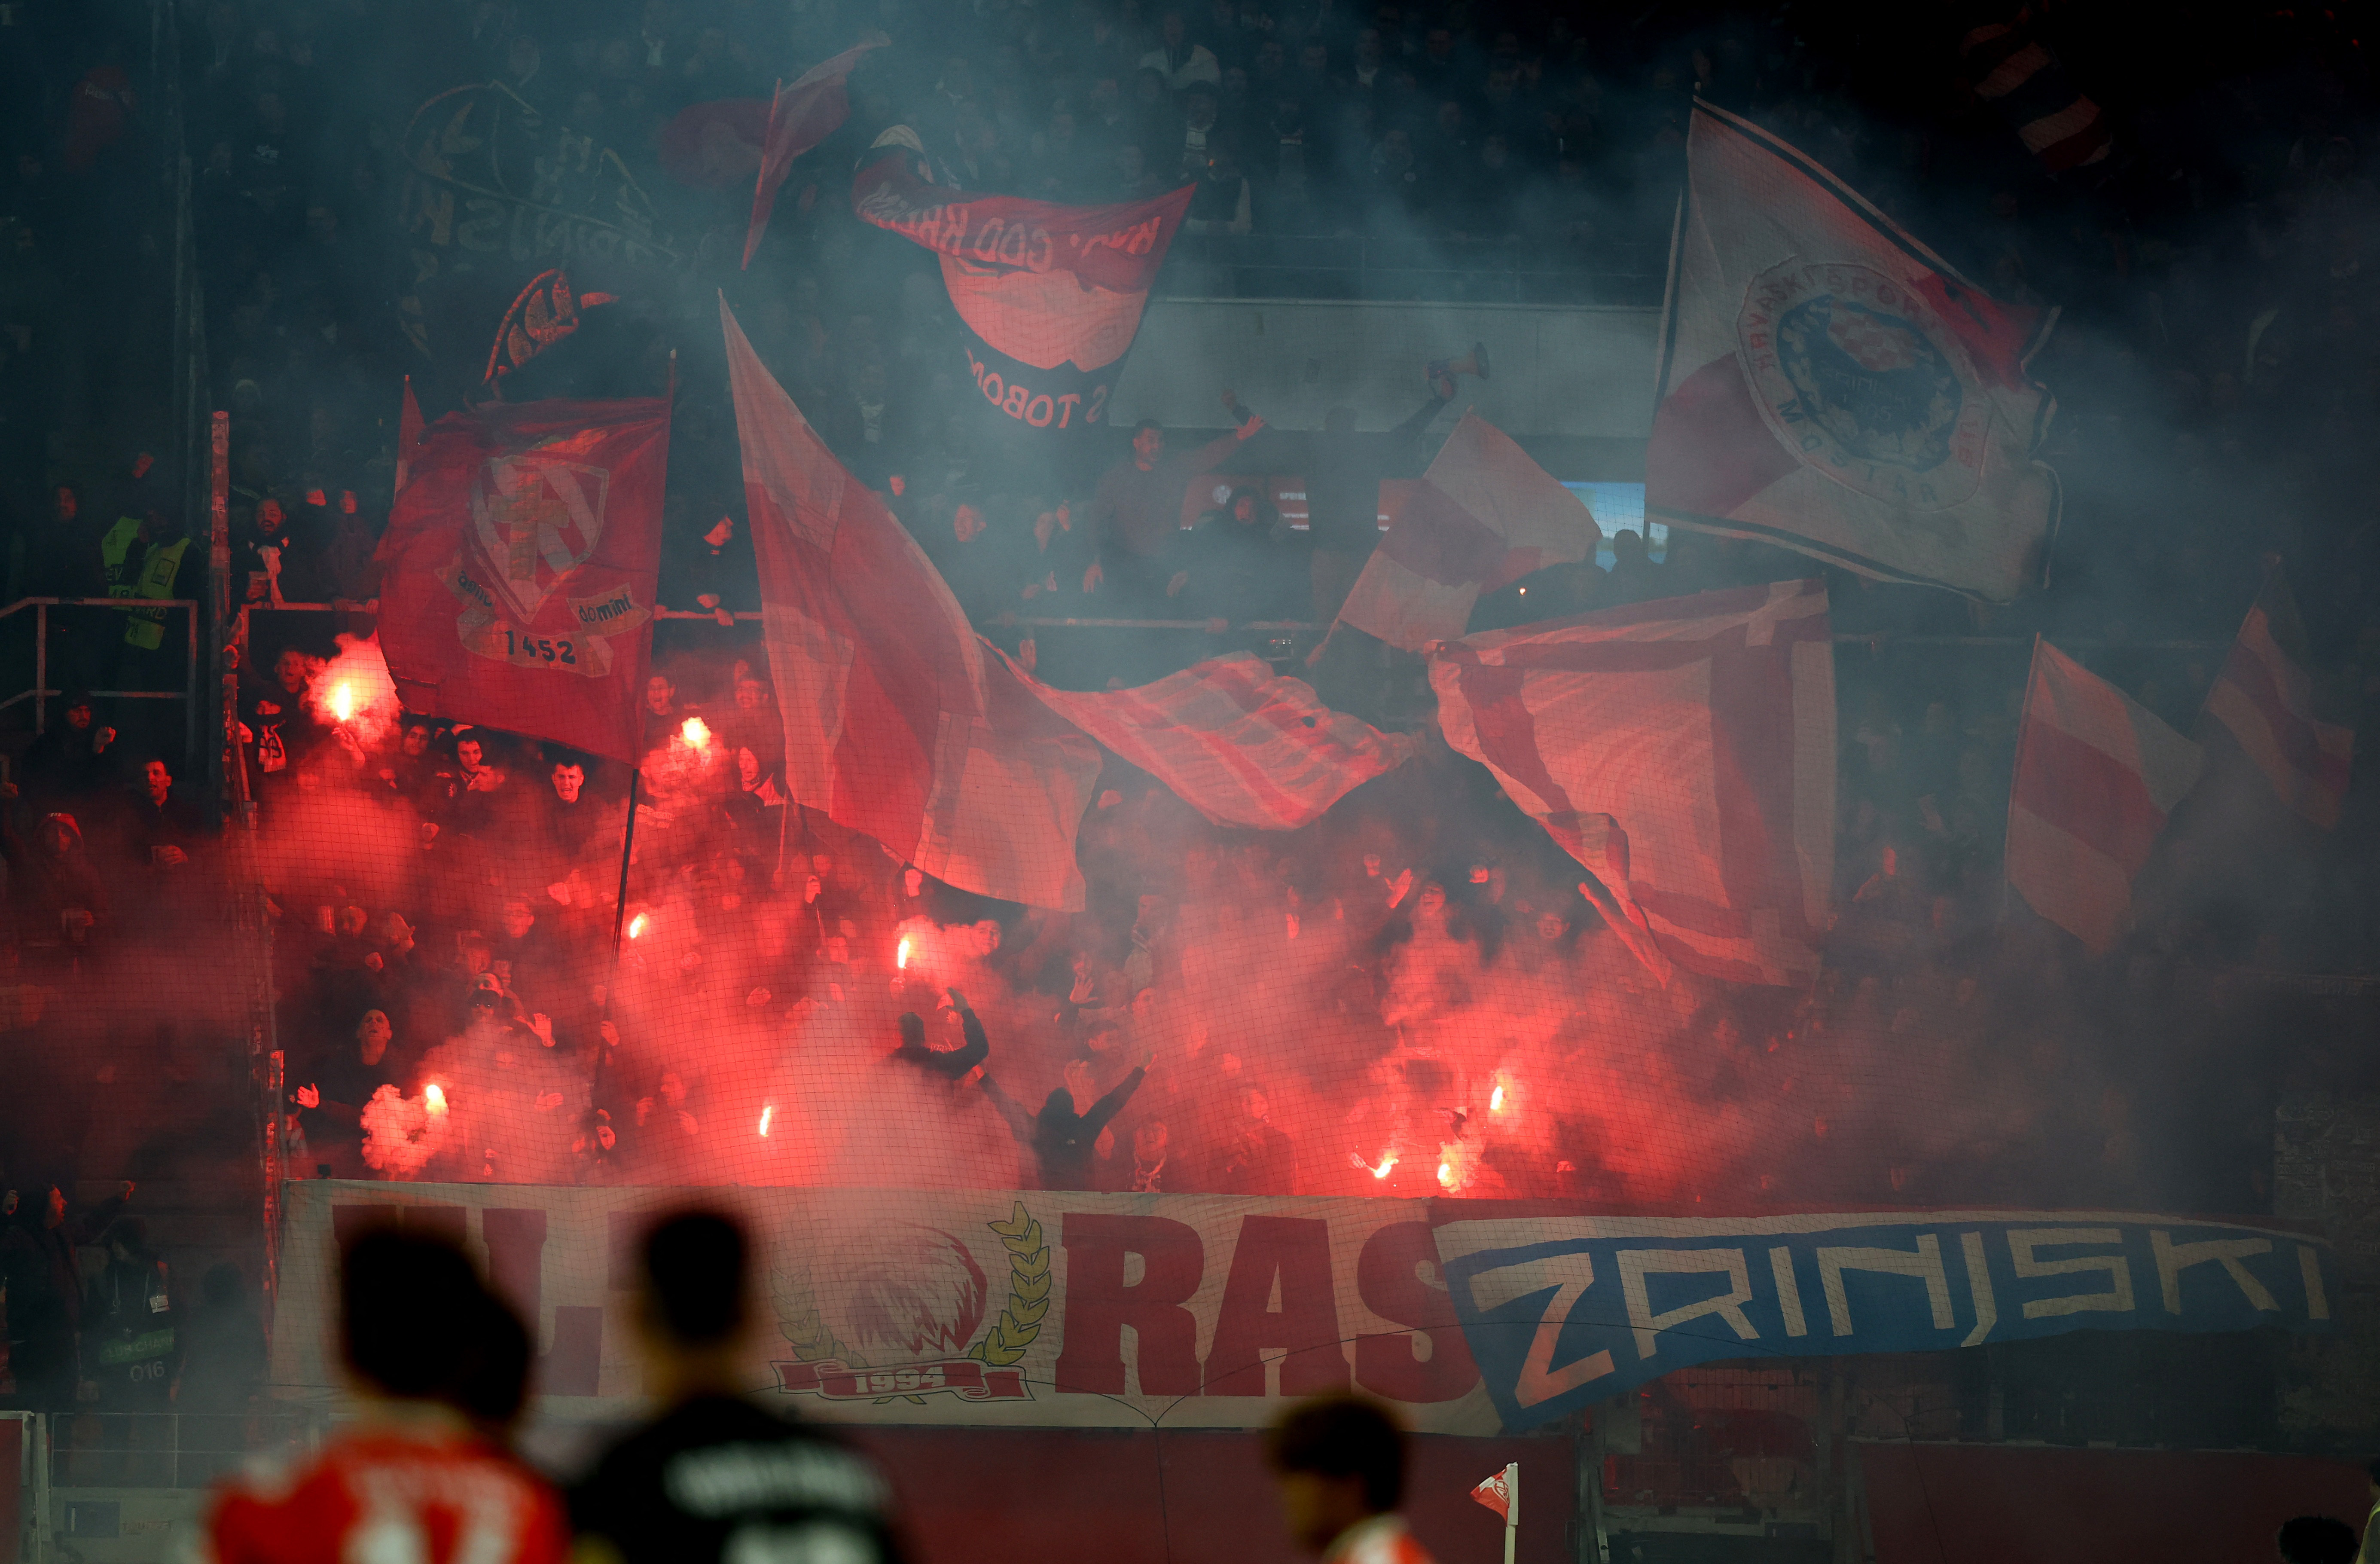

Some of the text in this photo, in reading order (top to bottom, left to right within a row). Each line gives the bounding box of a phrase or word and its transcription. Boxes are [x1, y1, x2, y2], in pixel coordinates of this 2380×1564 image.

[579, 594, 632, 623] domini
[505, 630, 576, 665] 1452
[1469, 1227, 2330, 1409] ZRINJSKI
[855, 1367, 945, 1393] 1994
